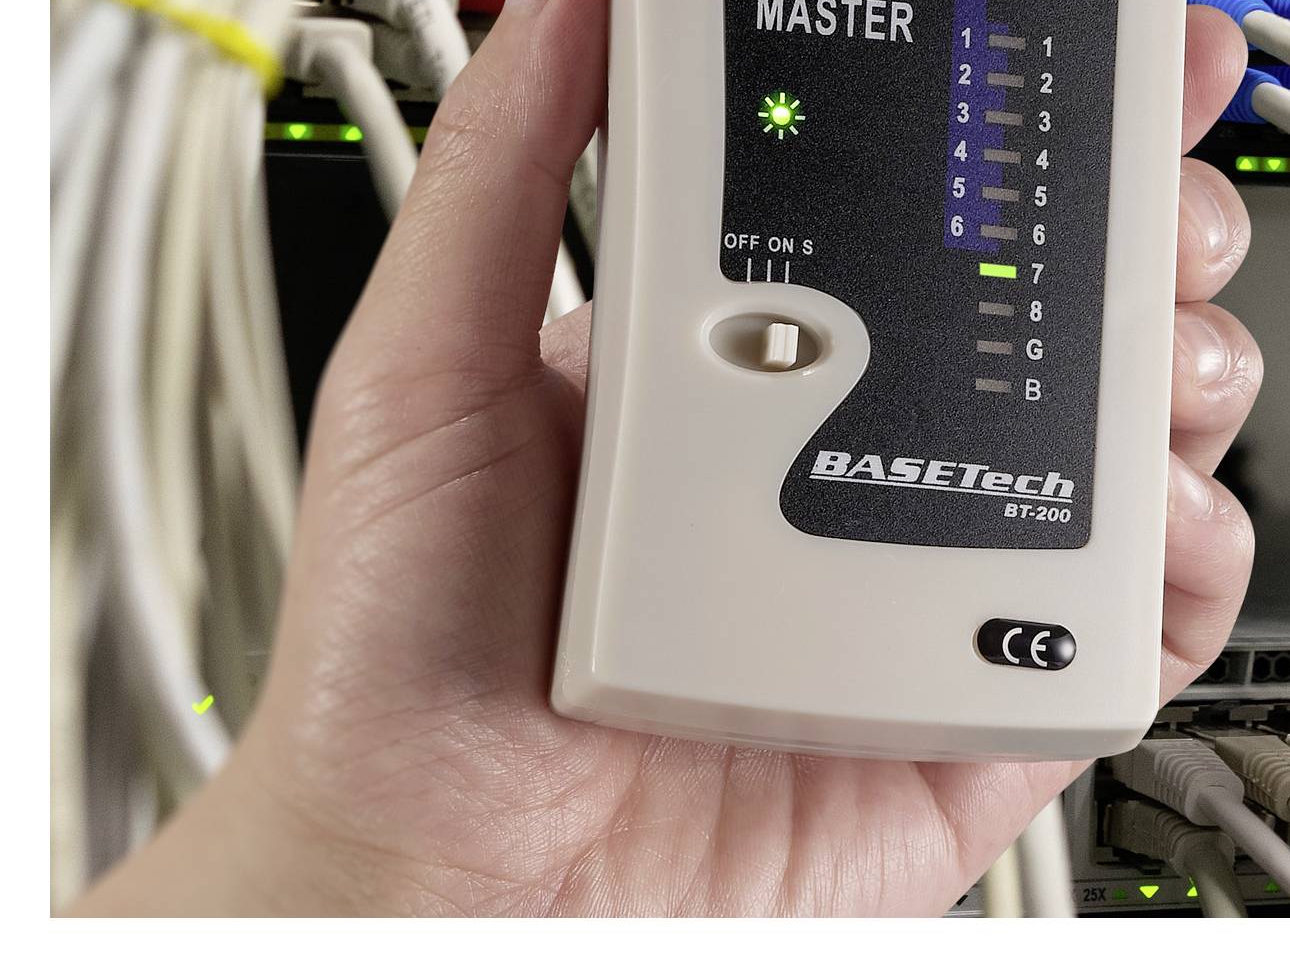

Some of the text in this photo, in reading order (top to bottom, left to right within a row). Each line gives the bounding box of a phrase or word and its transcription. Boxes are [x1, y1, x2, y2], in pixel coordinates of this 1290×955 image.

[961, 27, 1052, 57] 1 1
[958, 63, 1053, 94] 2 2
[956, 102, 1051, 132] 3 3
[953, 140, 1050, 170] 4 4
[952, 177, 1047, 207] 5 5
[724, 233, 813, 255] OFF ON S
[950, 215, 1046, 246] 6 6
[1031, 262, 1045, 285] 7
[1029, 300, 1043, 322] 8
[1025, 338, 1044, 361] G
[1025, 378, 1042, 401] B
[811, 449, 1077, 499] BASETech
[1003, 502, 1073, 525] BT-200
[1001, 626, 1052, 669] CE
[1083, 887, 1106, 902] 25X
